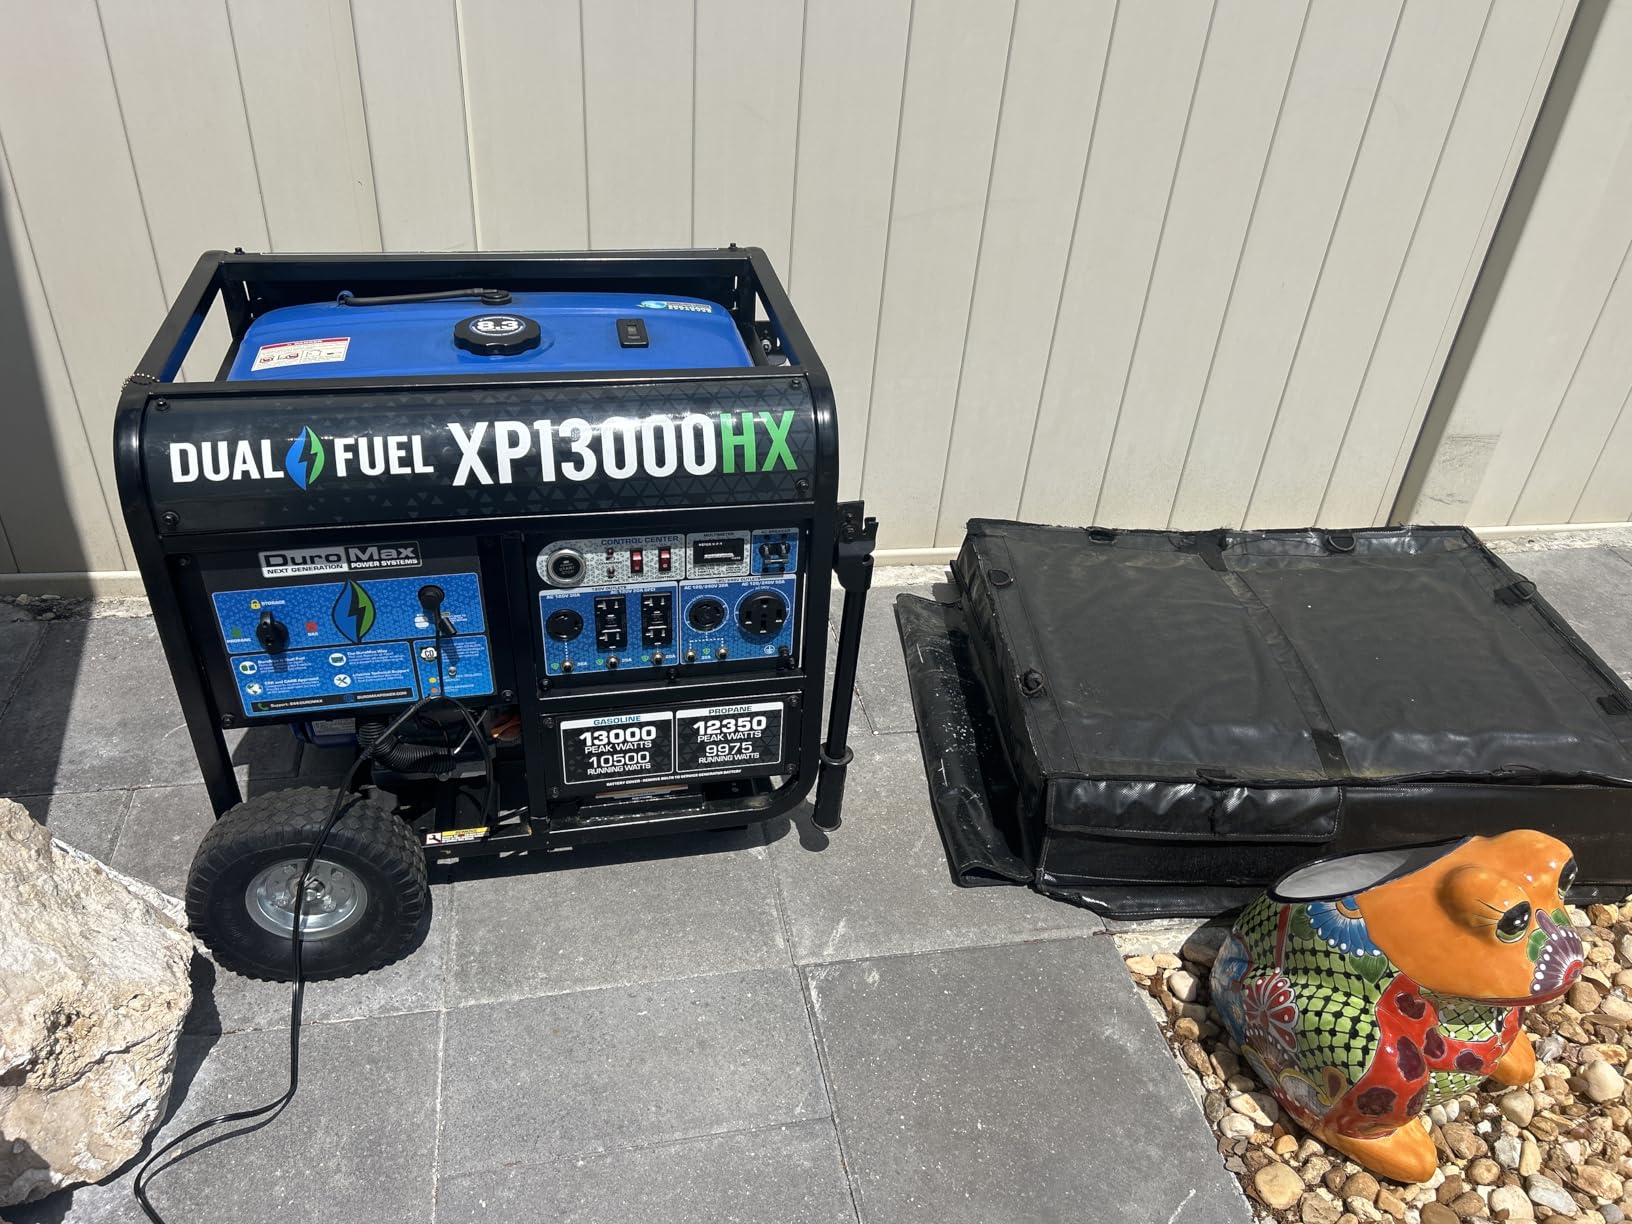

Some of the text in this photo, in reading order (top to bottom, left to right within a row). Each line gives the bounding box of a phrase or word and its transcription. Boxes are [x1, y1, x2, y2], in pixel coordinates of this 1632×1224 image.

[477, 320, 519, 332] 8.3
[169, 410, 798, 486] DUAL FUEL XP13000HX
[601, 535, 679, 546] CONTROL CENTER
[264, 546, 416, 568] Duro Max
[267, 567, 288, 575] NEXT
[291, 563, 343, 573] GENERATION
[381, 558, 418, 566] SYSTEMS
[708, 706, 753, 715] PROPANE
[593, 715, 641, 726] GASOLINE
[692, 716, 767, 735] 12350
[579, 726, 656, 746] 13000
[697, 730, 762, 743] PEAK WATTS
[585, 741, 652, 754] PEAK WATTS
[705, 742, 753, 757] 9975
[589, 751, 650, 768] 10500
[698, 752, 760, 763] RUNNING WATTS
[587, 762, 651, 775] RUNNING WATTS
